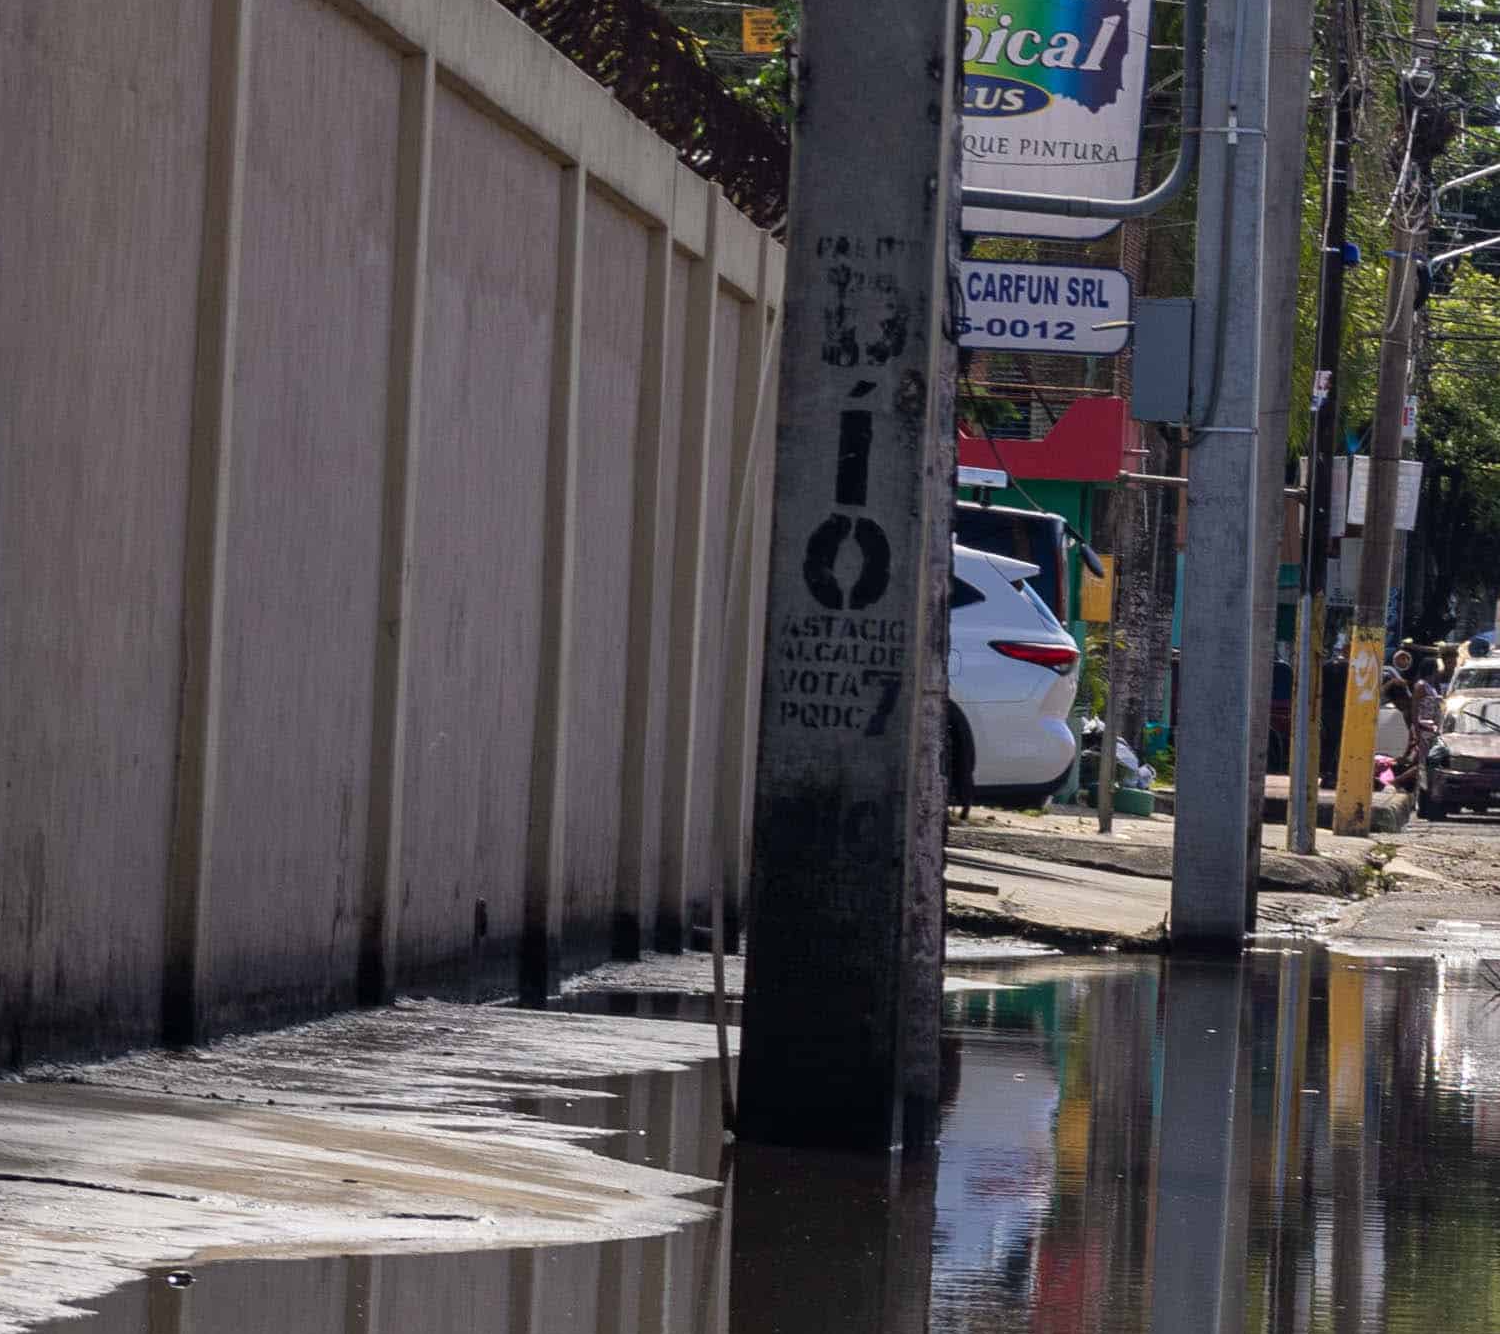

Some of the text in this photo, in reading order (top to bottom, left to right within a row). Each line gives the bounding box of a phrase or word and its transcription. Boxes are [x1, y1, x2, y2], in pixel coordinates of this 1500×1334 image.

[963, 134, 1120, 161] QUE PINTURA
[966, 272, 1109, 308] CARFUN SRL
[779, 669, 901, 736] VOTA 7
